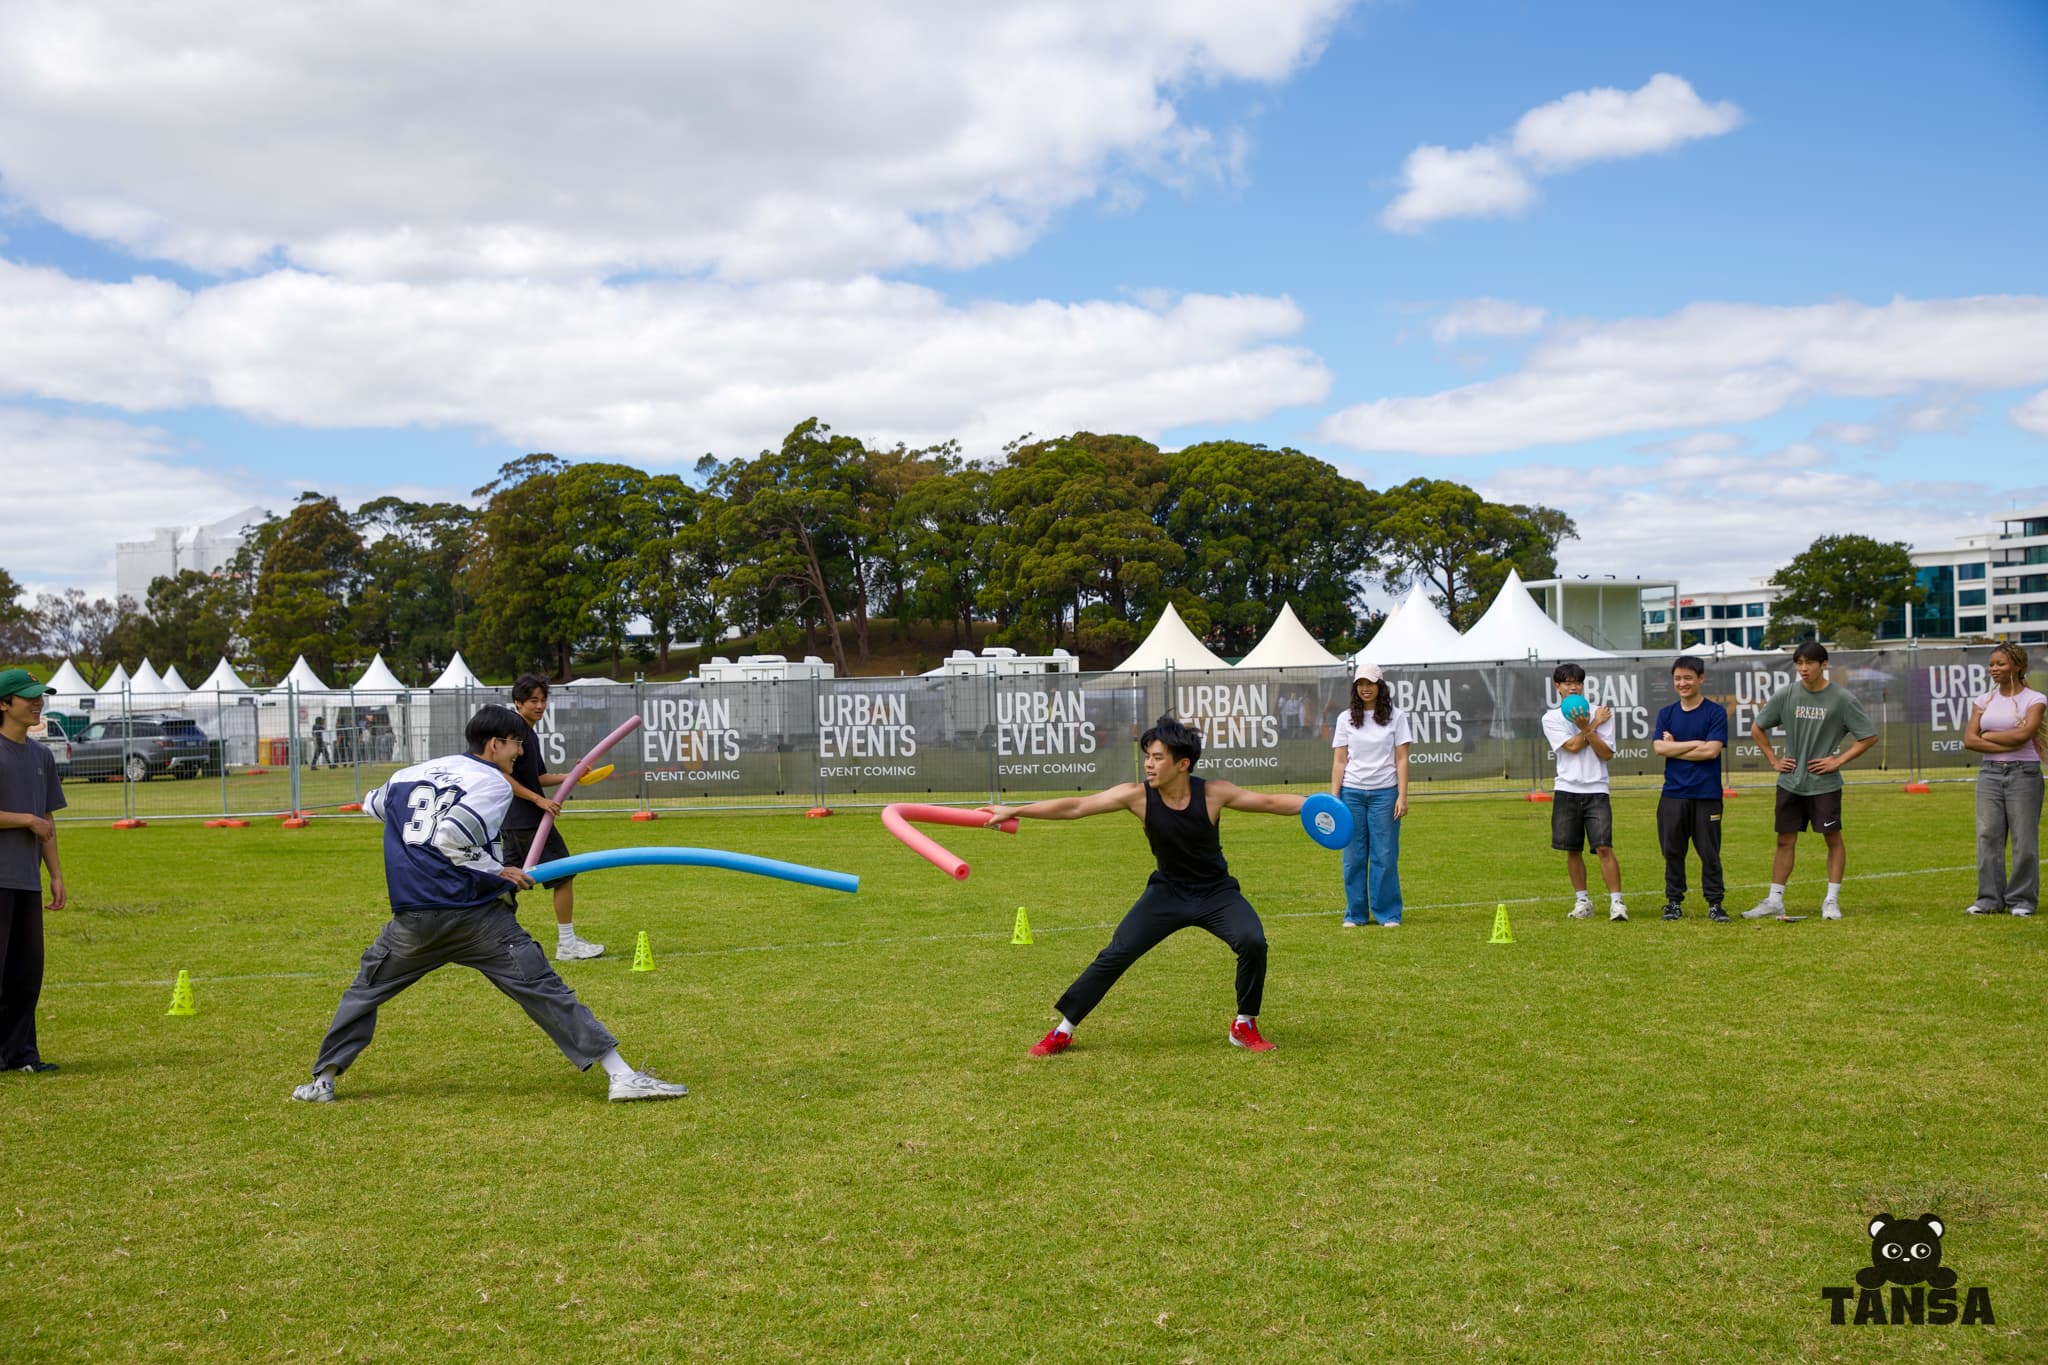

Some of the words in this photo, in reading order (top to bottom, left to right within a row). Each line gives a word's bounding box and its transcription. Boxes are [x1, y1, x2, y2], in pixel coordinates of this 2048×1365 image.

[1385, 679, 1452, 712] BAN
[1545, 675, 1638, 708] UBAN
[1929, 664, 1995, 698] URB
[643, 698, 730, 731] URBAN
[819, 693, 906, 726] URBAN
[997, 690, 1086, 723] URBAN
[1178, 684, 1267, 718] URBAN
[820, 725, 917, 757] EVENTS
[997, 721, 1096, 755] EVENTS
[1406, 711, 1463, 744] NTS
[644, 729, 740, 762] EVENTS
[1408, 752, 1463, 764] COMING
[1612, 748, 1648, 759] MING
[1736, 745, 1780, 756] EVET
[645, 770, 686, 782] EVENT
[688, 770, 740, 781] COMING
[820, 766, 862, 777] EVENT
[863, 766, 916, 776] COMING
[998, 764, 1040, 775] EVENT
[1042, 763, 1096, 774] COMING
[1197, 758, 1223, 769] ENT
[1224, 757, 1278, 768] COMING
